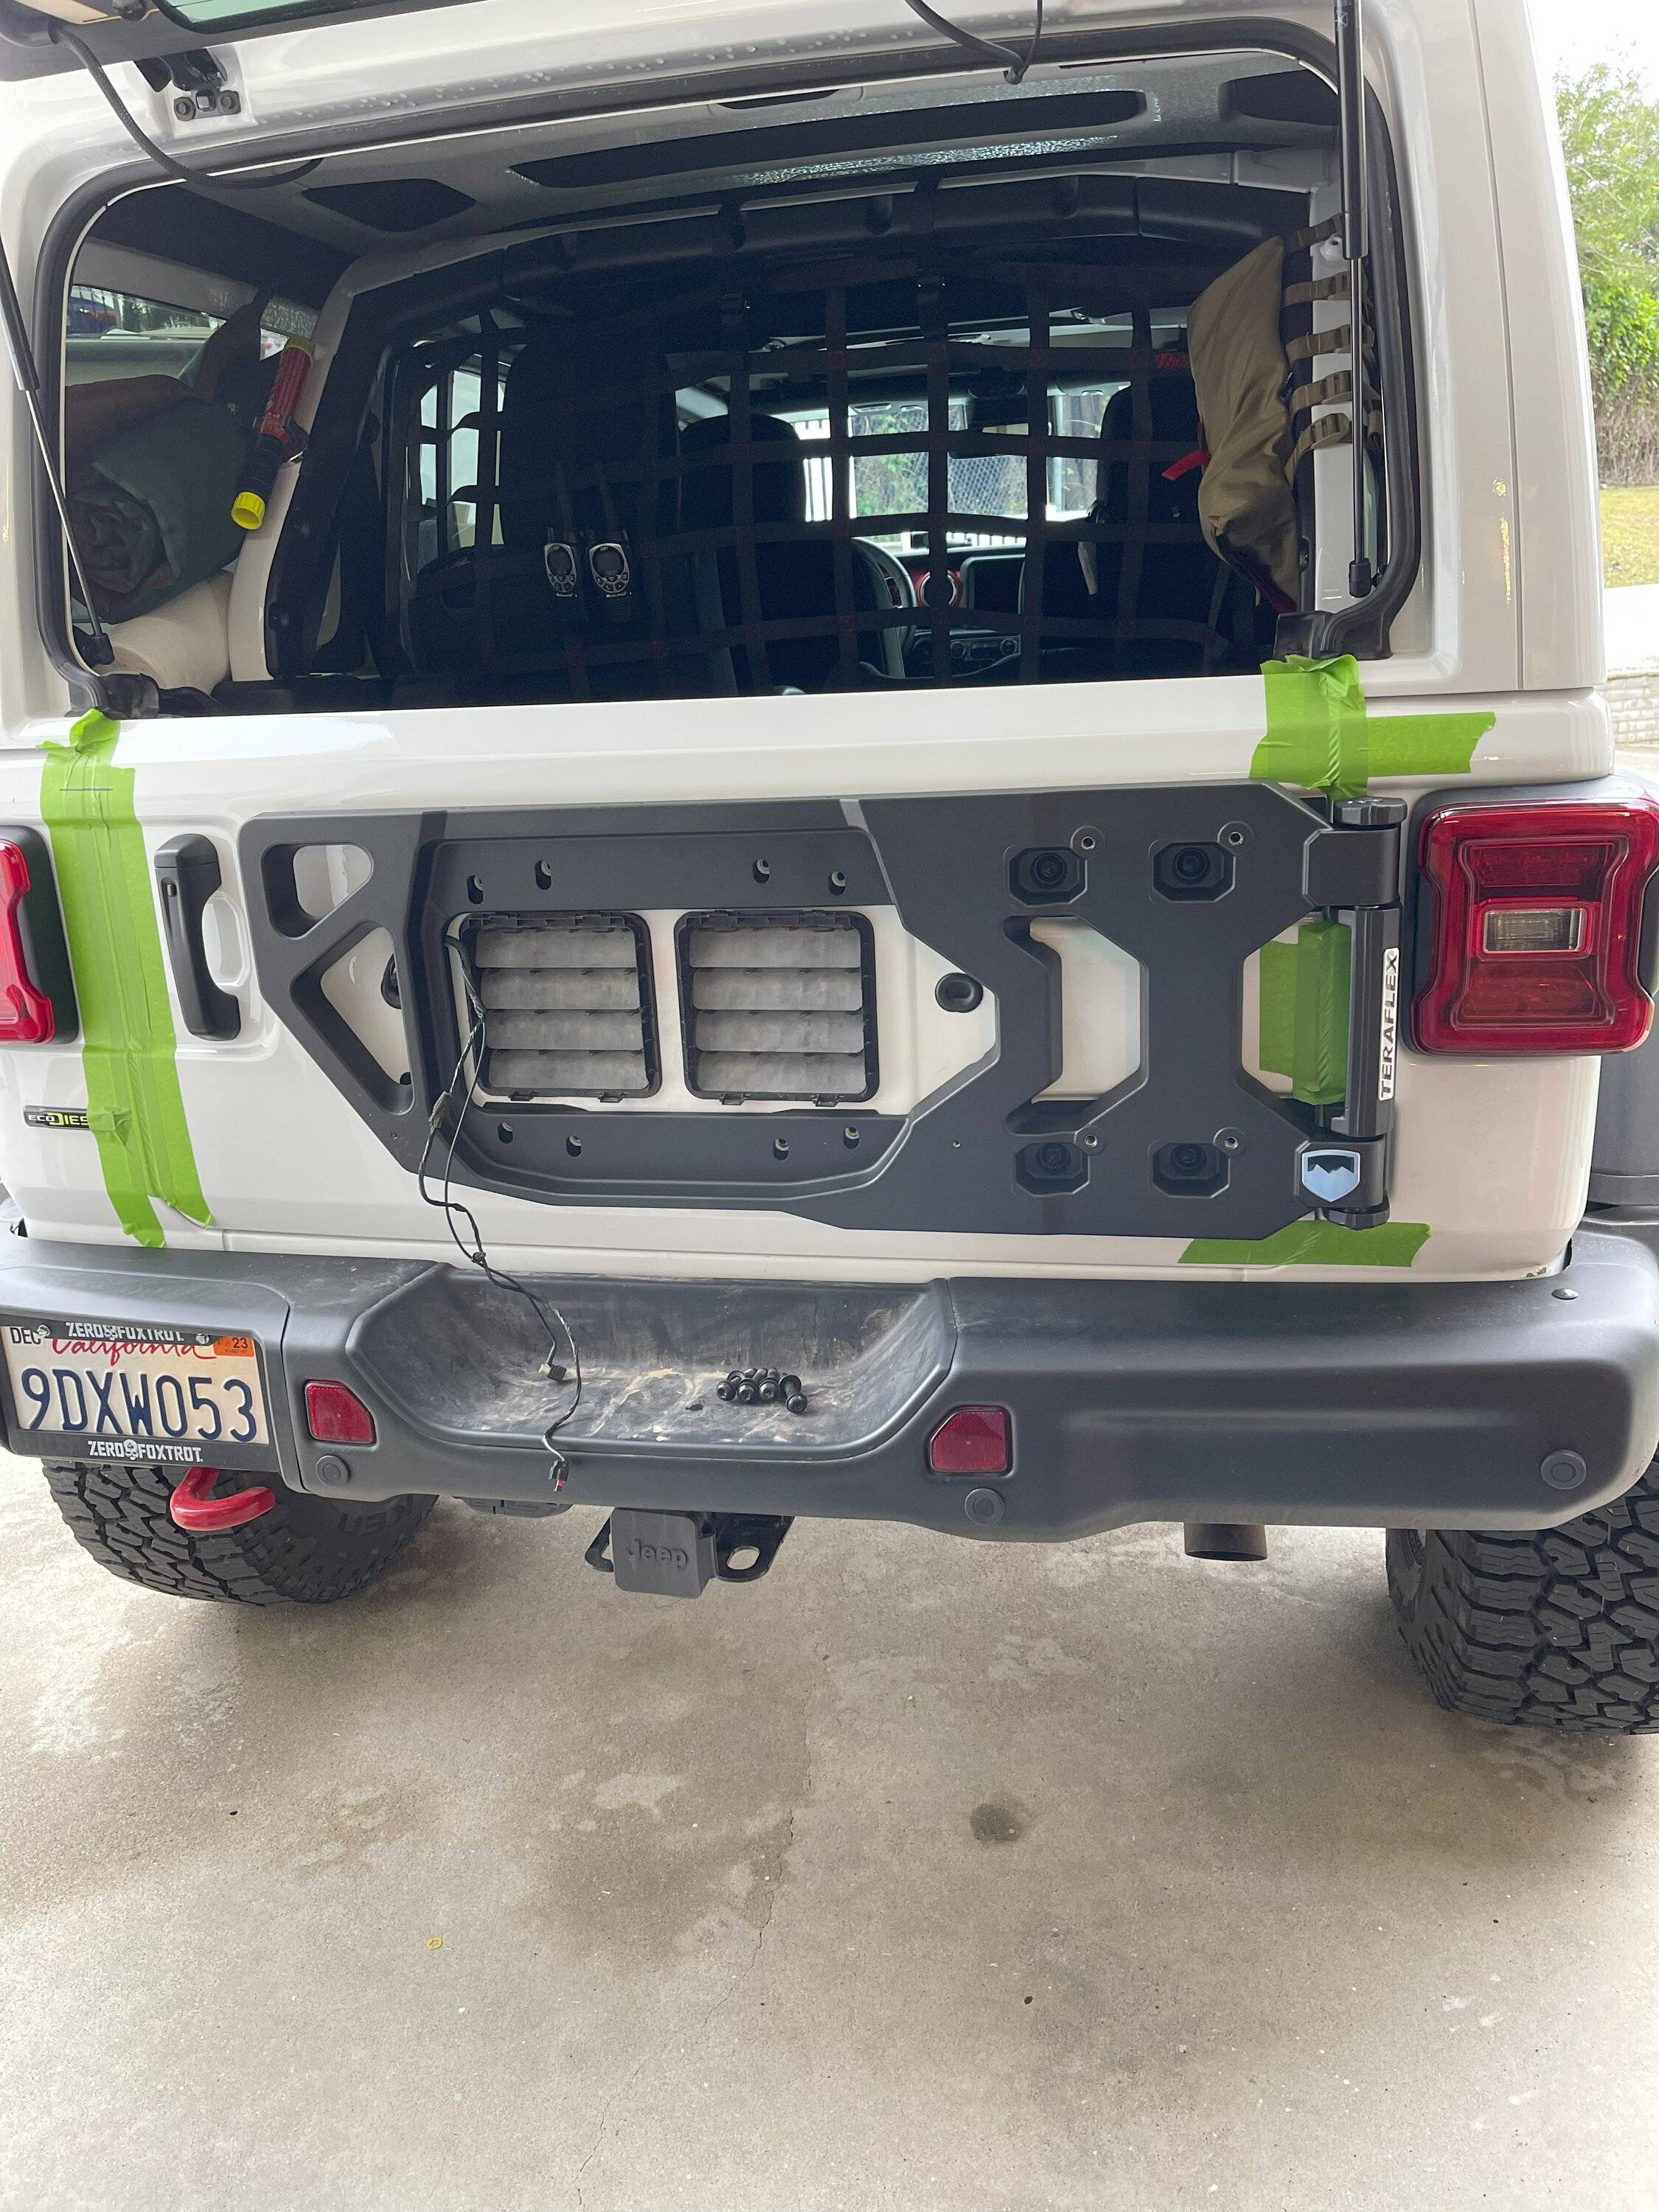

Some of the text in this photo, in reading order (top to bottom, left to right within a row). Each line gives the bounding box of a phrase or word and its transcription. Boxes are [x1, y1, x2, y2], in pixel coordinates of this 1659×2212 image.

[1382, 954, 1397, 1098] TERAFLEX
[28, 1113, 88, 1125] ECODIES
[10, 1327, 41, 1345] DEC
[66, 1322, 105, 1339] ZERO
[232, 1338, 248, 1349] 23
[21, 1368, 257, 1442] 9DXW053
[88, 1441, 125, 1457] ZERO
[627, 1537, 688, 1569] Jeep
